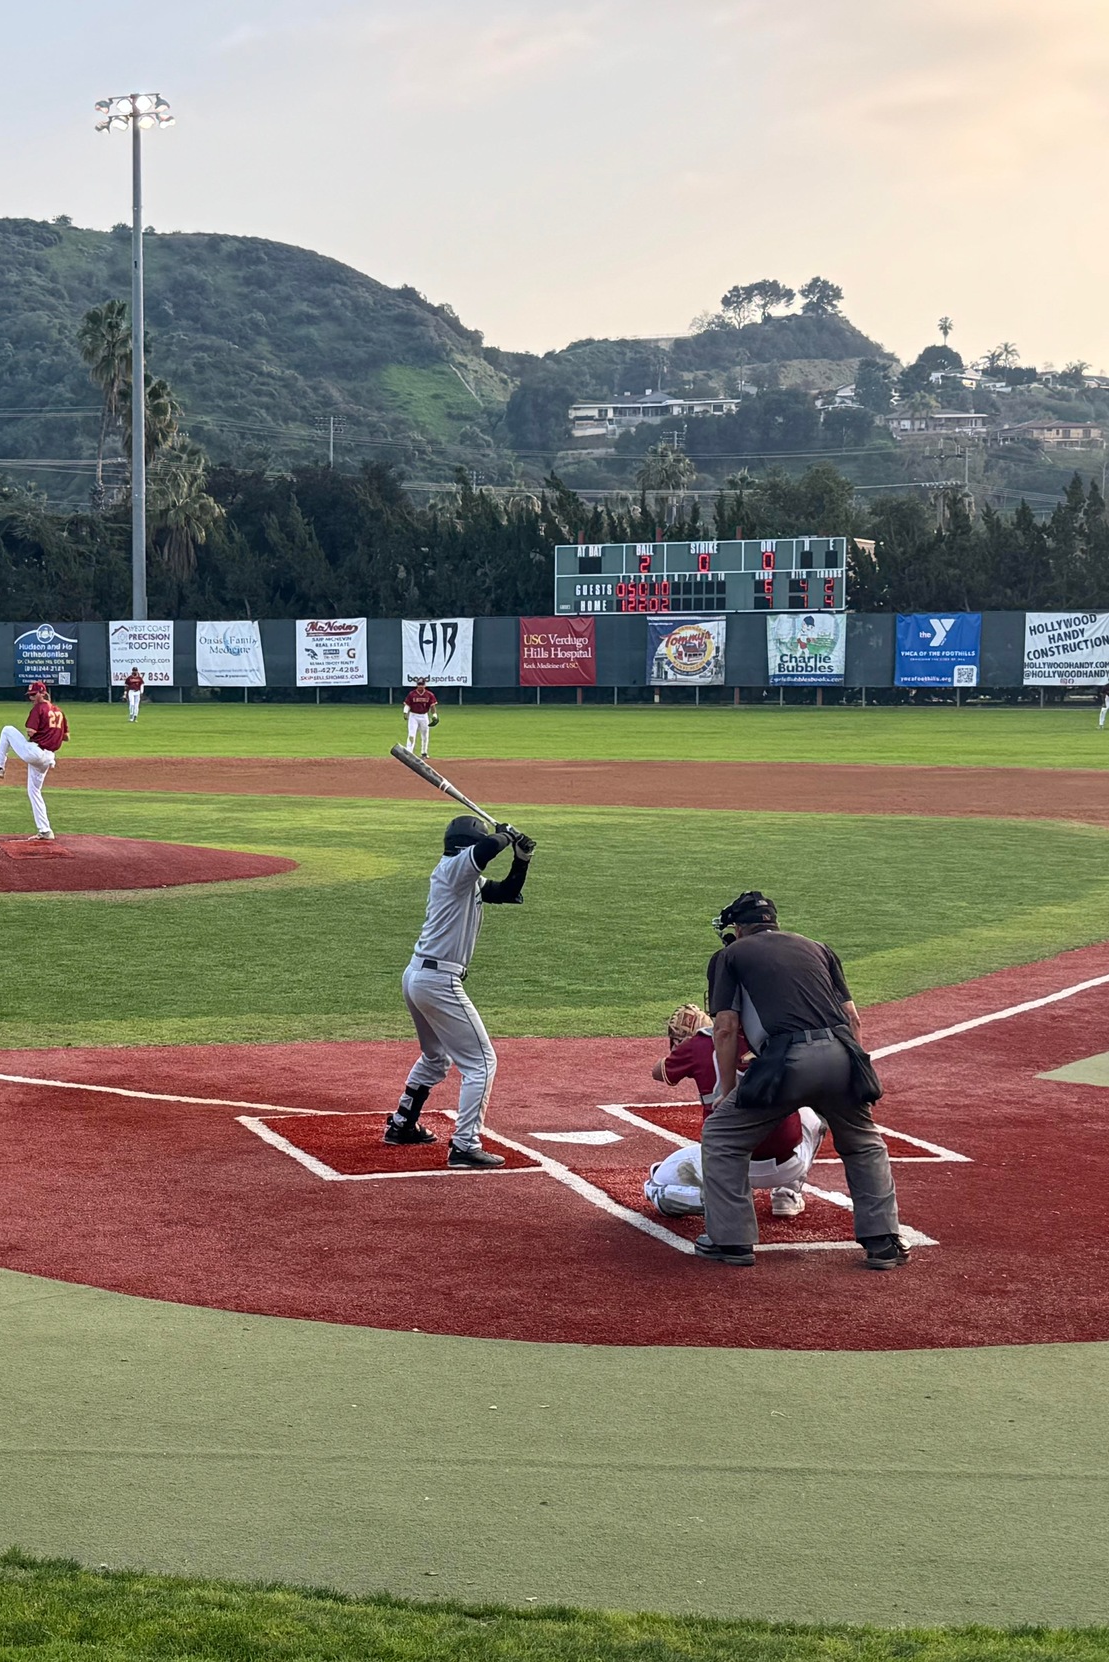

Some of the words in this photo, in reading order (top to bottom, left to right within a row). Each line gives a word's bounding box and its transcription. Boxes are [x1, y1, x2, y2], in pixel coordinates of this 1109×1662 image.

[636, 544, 654, 556] BALL
[690, 543, 718, 554] STRIKE
[761, 541, 776, 552] OUT
[640, 556, 650, 573] 2
[699, 554, 709, 571] 0
[763, 552, 774, 570] 0
[575, 584, 612, 595] GUESTS
[764, 580, 772, 593] 6
[825, 578, 833, 593] 2
[580, 600, 607, 611] HOME
[825, 596, 833, 607] 4
[1028, 613, 1097, 636] HOLLYWOOD
[128, 633, 171, 641] PRECISION
[229, 635, 258, 646] Family
[523, 633, 547, 645] USC
[548, 633, 589, 648] Verdugo
[660, 630, 712, 648] Tommy's
[1047, 628, 1085, 645] HANDY
[128, 642, 171, 650] ROOFING
[209, 645, 251, 654] Medicine
[1026, 635, 1109, 661] CONSTRUCTION
[347, 648, 356, 659] G
[523, 647, 549, 659] Hills
[550, 646, 592, 661] Hospital
[779, 653, 832, 664] Charlie
[777, 663, 834, 673] Bubbles
[1024, 661, 1109, 669] HOLLYWOODHANDY.COM
[148, 672, 170, 682] 8536
[1024, 670, 1109, 680] @HOLLYWOODHANDY
[48, 710, 63, 729] 27
